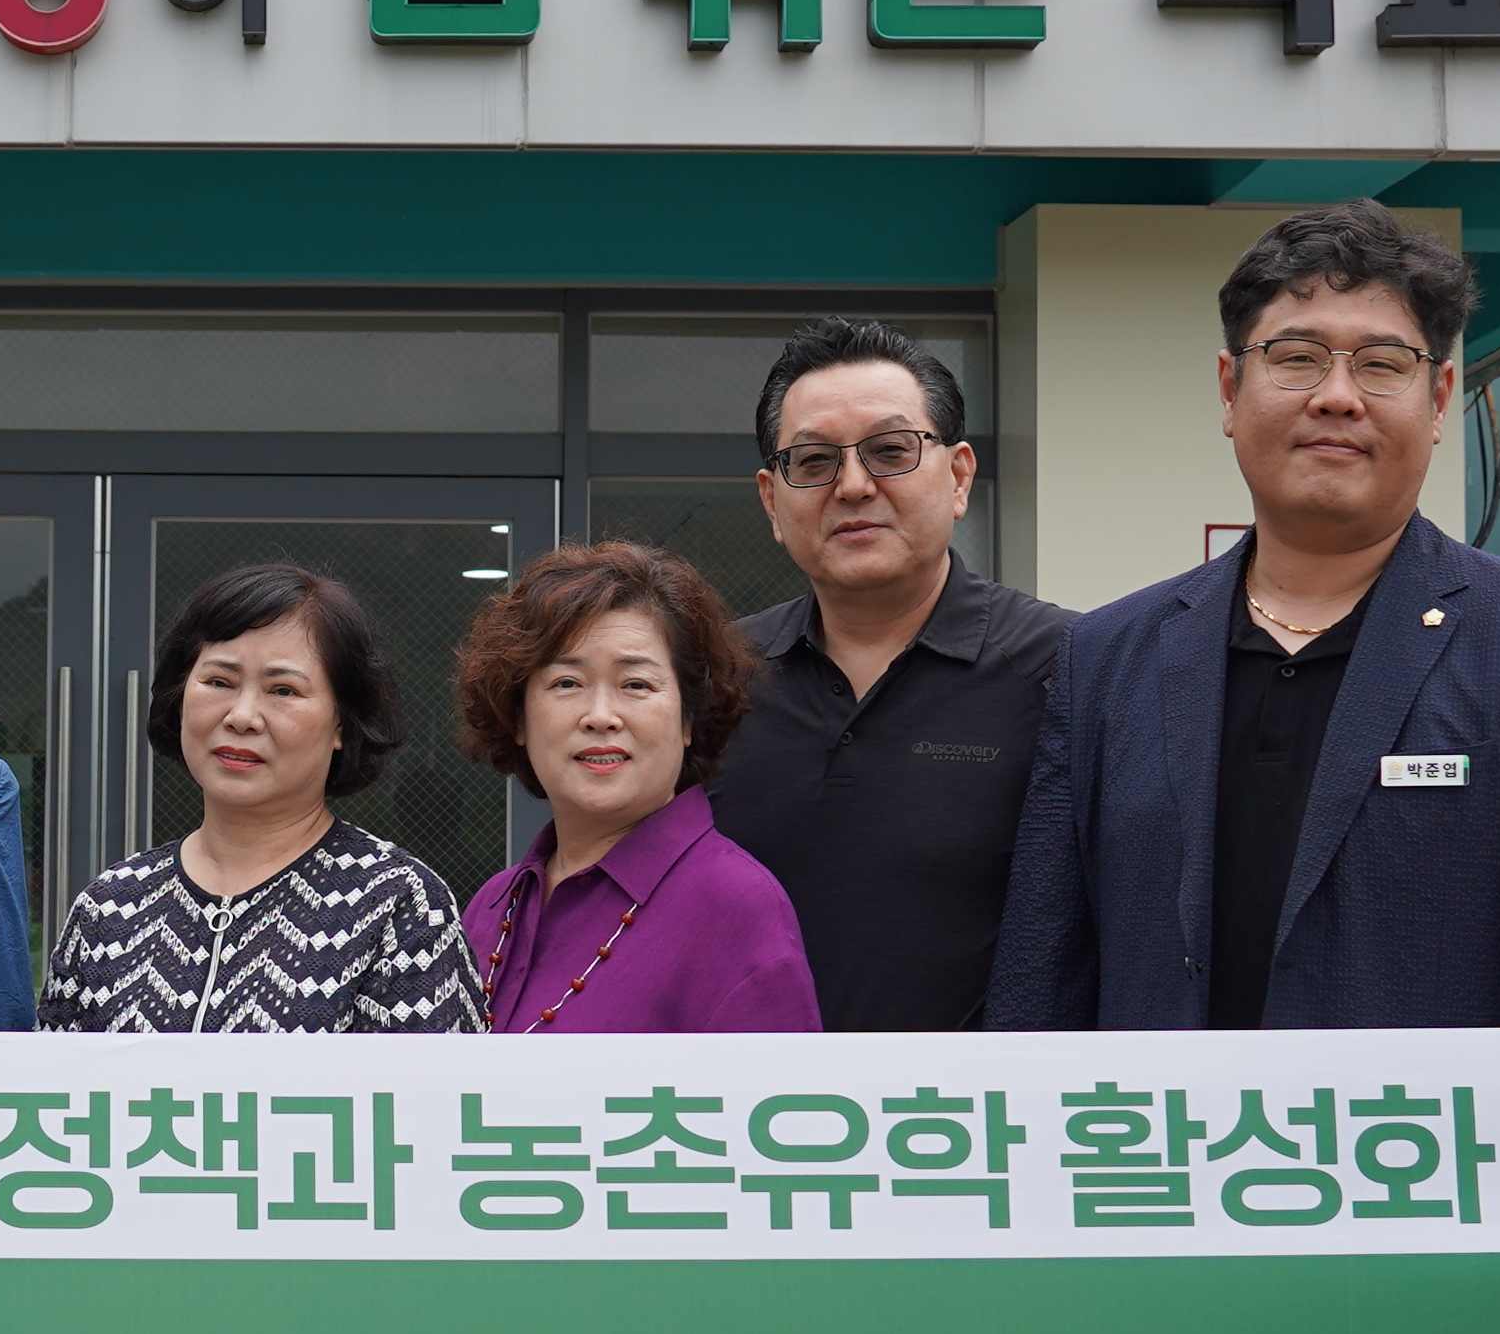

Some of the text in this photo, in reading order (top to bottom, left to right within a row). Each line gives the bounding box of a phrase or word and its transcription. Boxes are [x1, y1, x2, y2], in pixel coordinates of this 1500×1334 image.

[1407, 762, 1457, 779] 박준엽
[451, 1086, 1027, 1230] 농촌유학
[1060, 1081, 1496, 1228] 활성화
